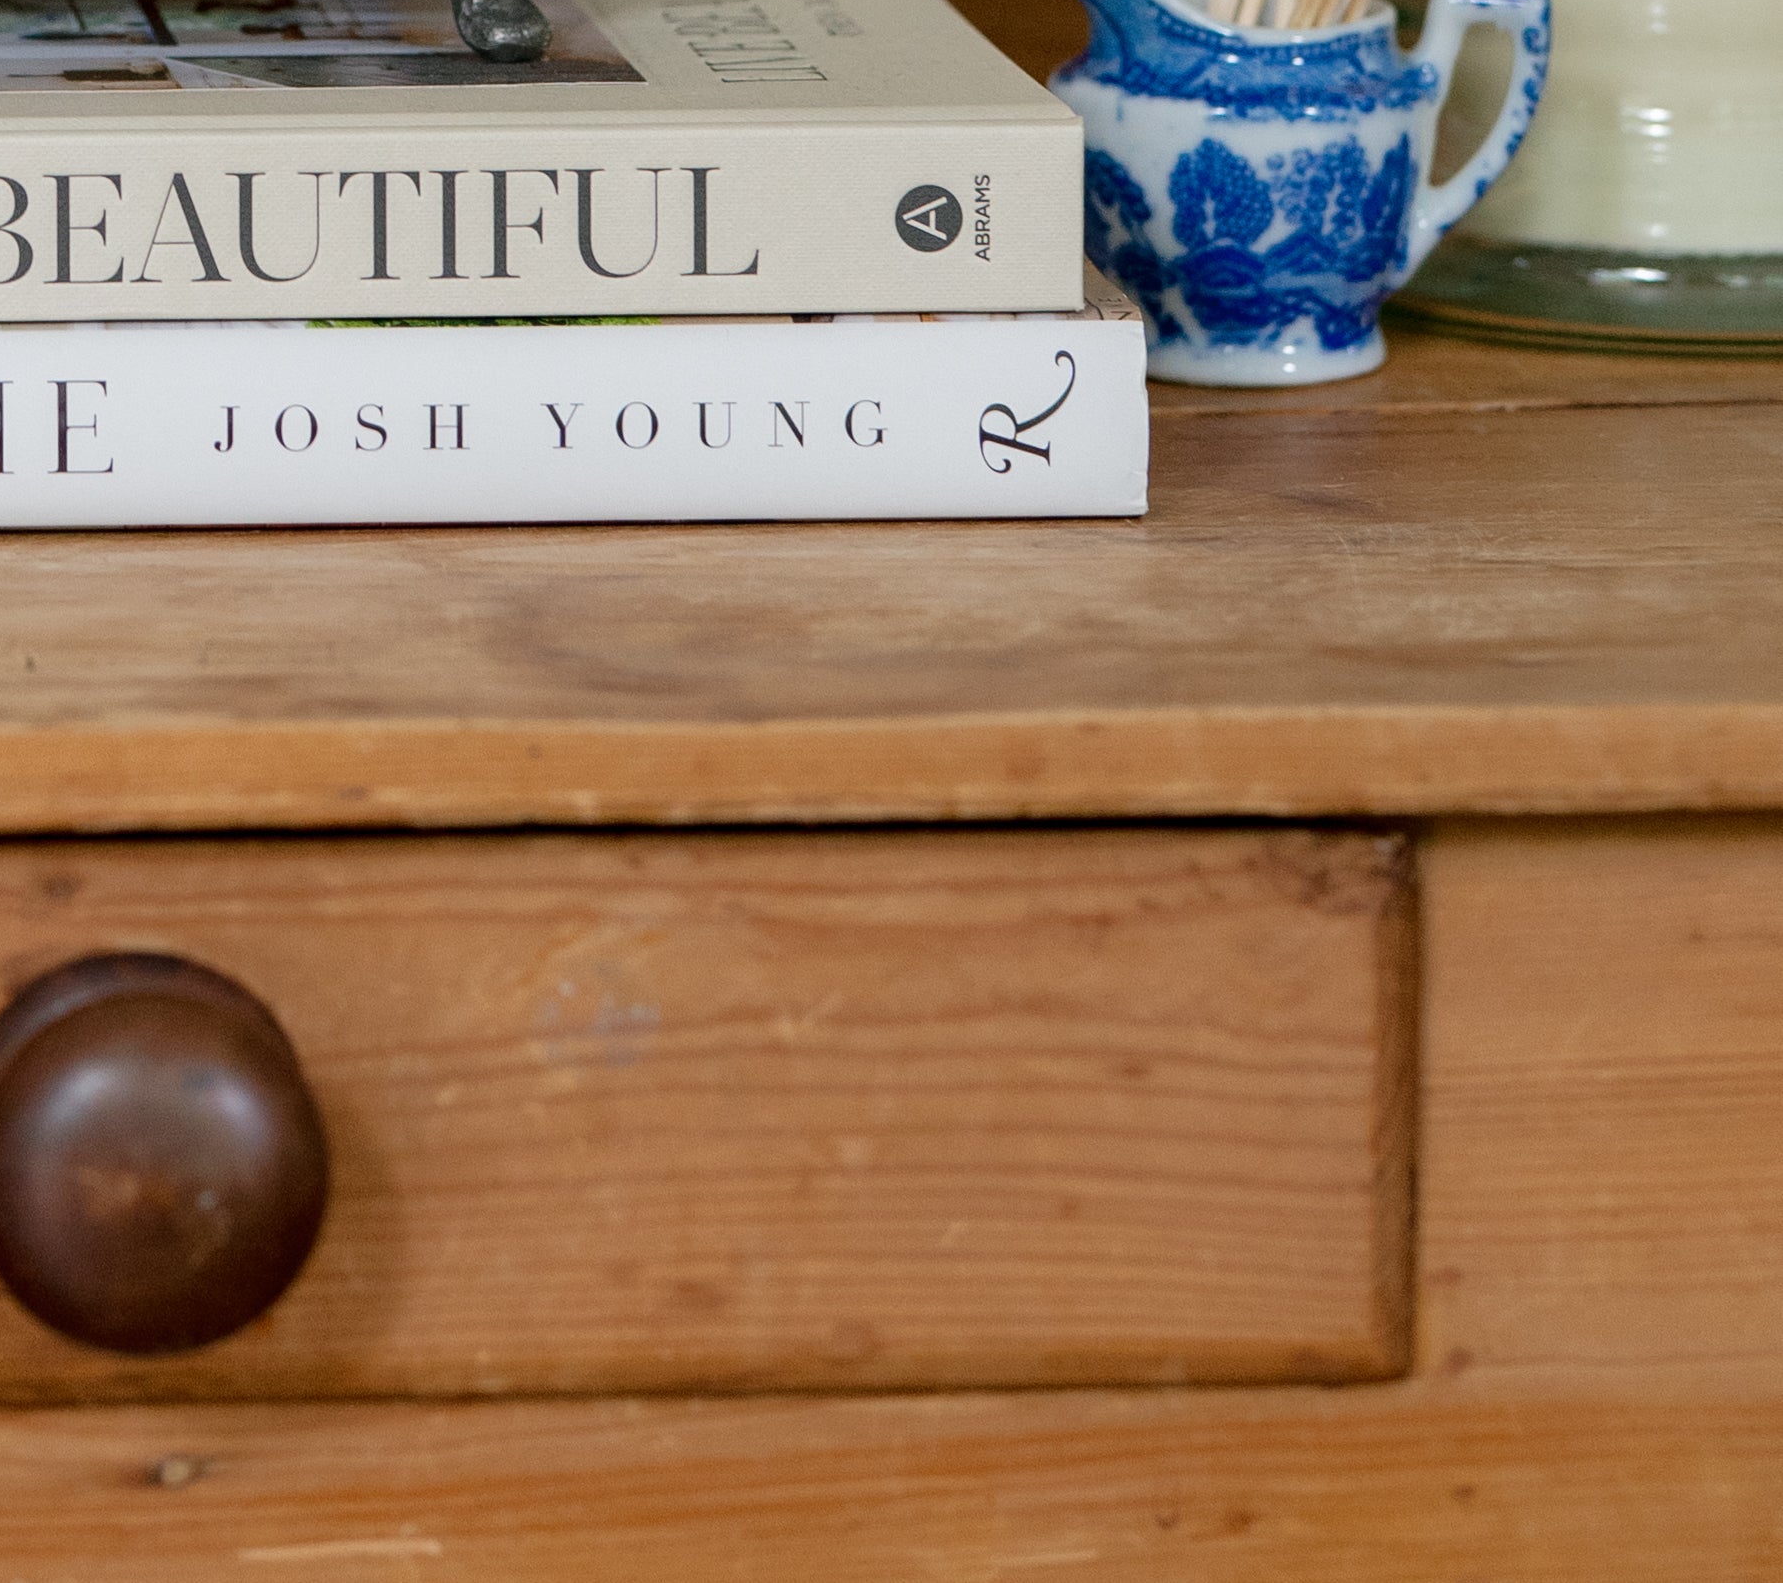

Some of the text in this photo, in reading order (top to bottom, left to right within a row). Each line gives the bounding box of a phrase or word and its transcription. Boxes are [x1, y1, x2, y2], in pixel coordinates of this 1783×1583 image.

[973, 173, 992, 263] ABRAMS
[212, 399, 889, 453] JOSH YOUNG
